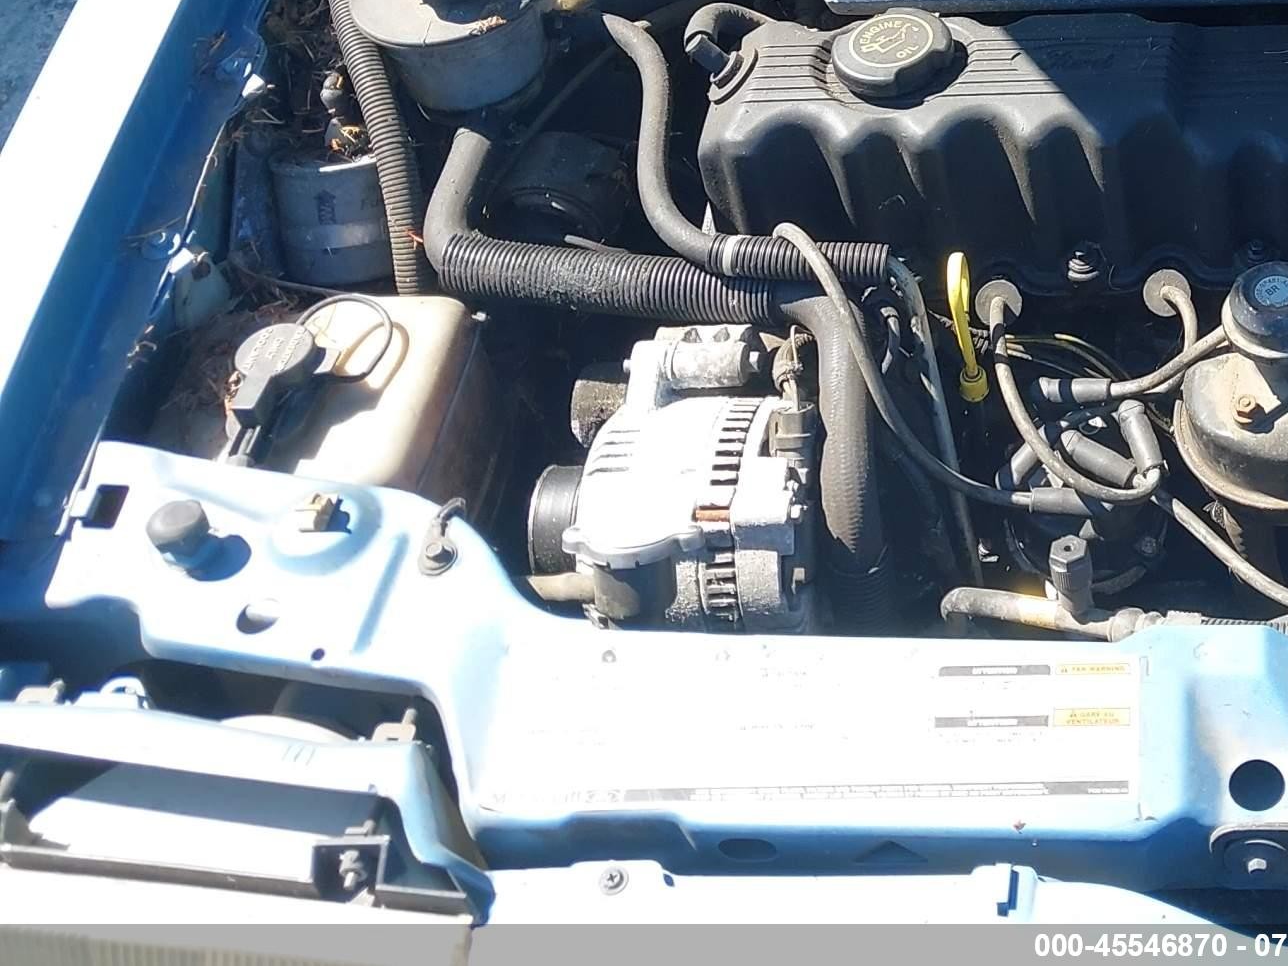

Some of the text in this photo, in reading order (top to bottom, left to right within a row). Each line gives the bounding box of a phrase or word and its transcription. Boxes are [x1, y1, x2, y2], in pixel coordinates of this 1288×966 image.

[860, 20, 904, 45] ENGINE
[896, 44, 919, 59] OIL
[1265, 285, 1280, 296] BR
[242, 327, 274, 371] COOLANT
